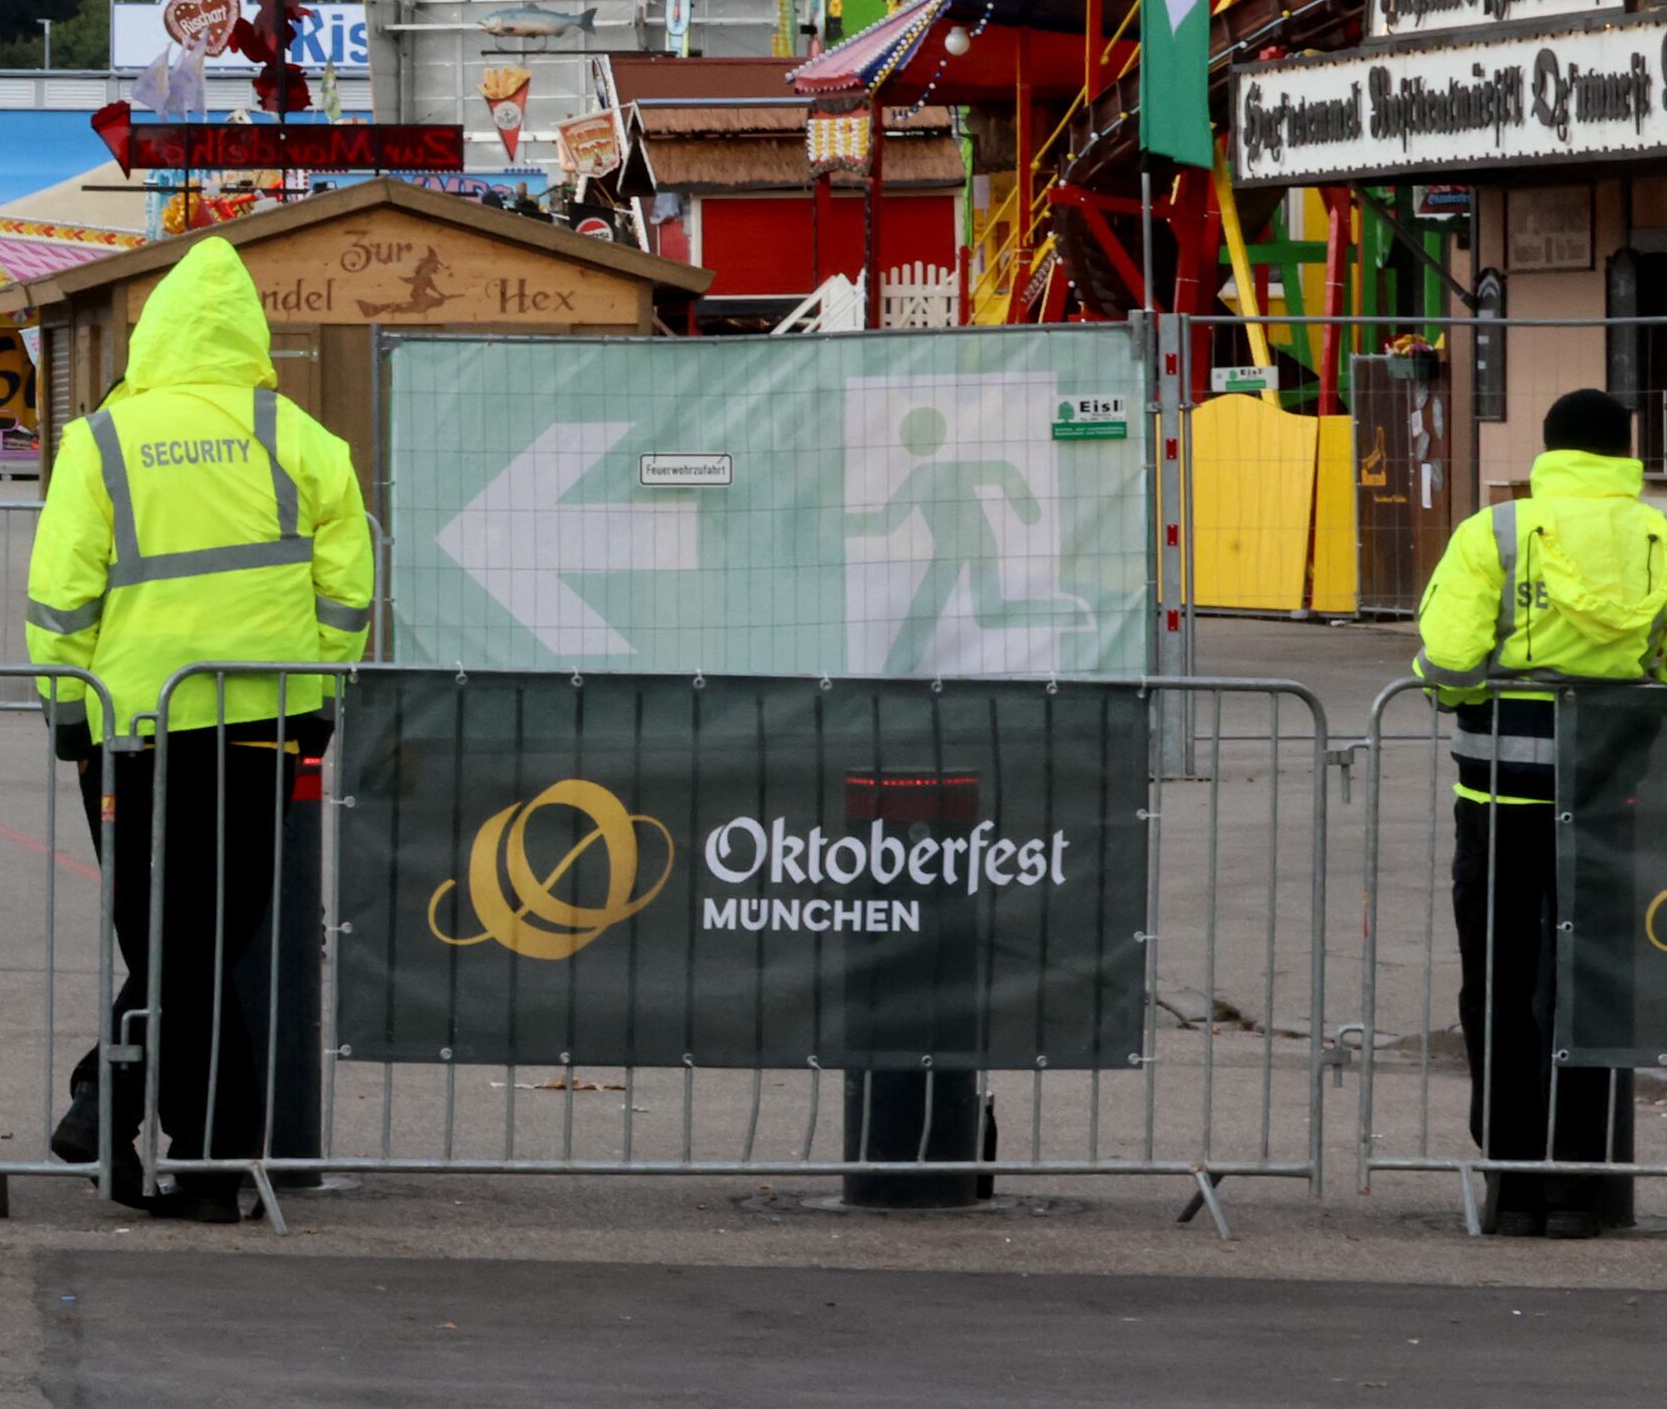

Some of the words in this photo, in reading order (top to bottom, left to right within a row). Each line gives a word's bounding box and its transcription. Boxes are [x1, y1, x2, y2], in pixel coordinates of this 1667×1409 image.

[181, 3, 229, 37] Rischart
[340, 229, 414, 274] Zur
[262, 277, 336, 312] ndel
[484, 278, 575, 314] Hex
[1079, 399, 1120, 413] Eisl
[140, 439, 250, 468] SECURITY
[645, 463, 726, 476] Feuerwehrzufahrt
[1517, 580, 1548, 610] SE
[705, 815, 1071, 896] Oktoberfest
[704, 897, 921, 933] MÜNCHEN
